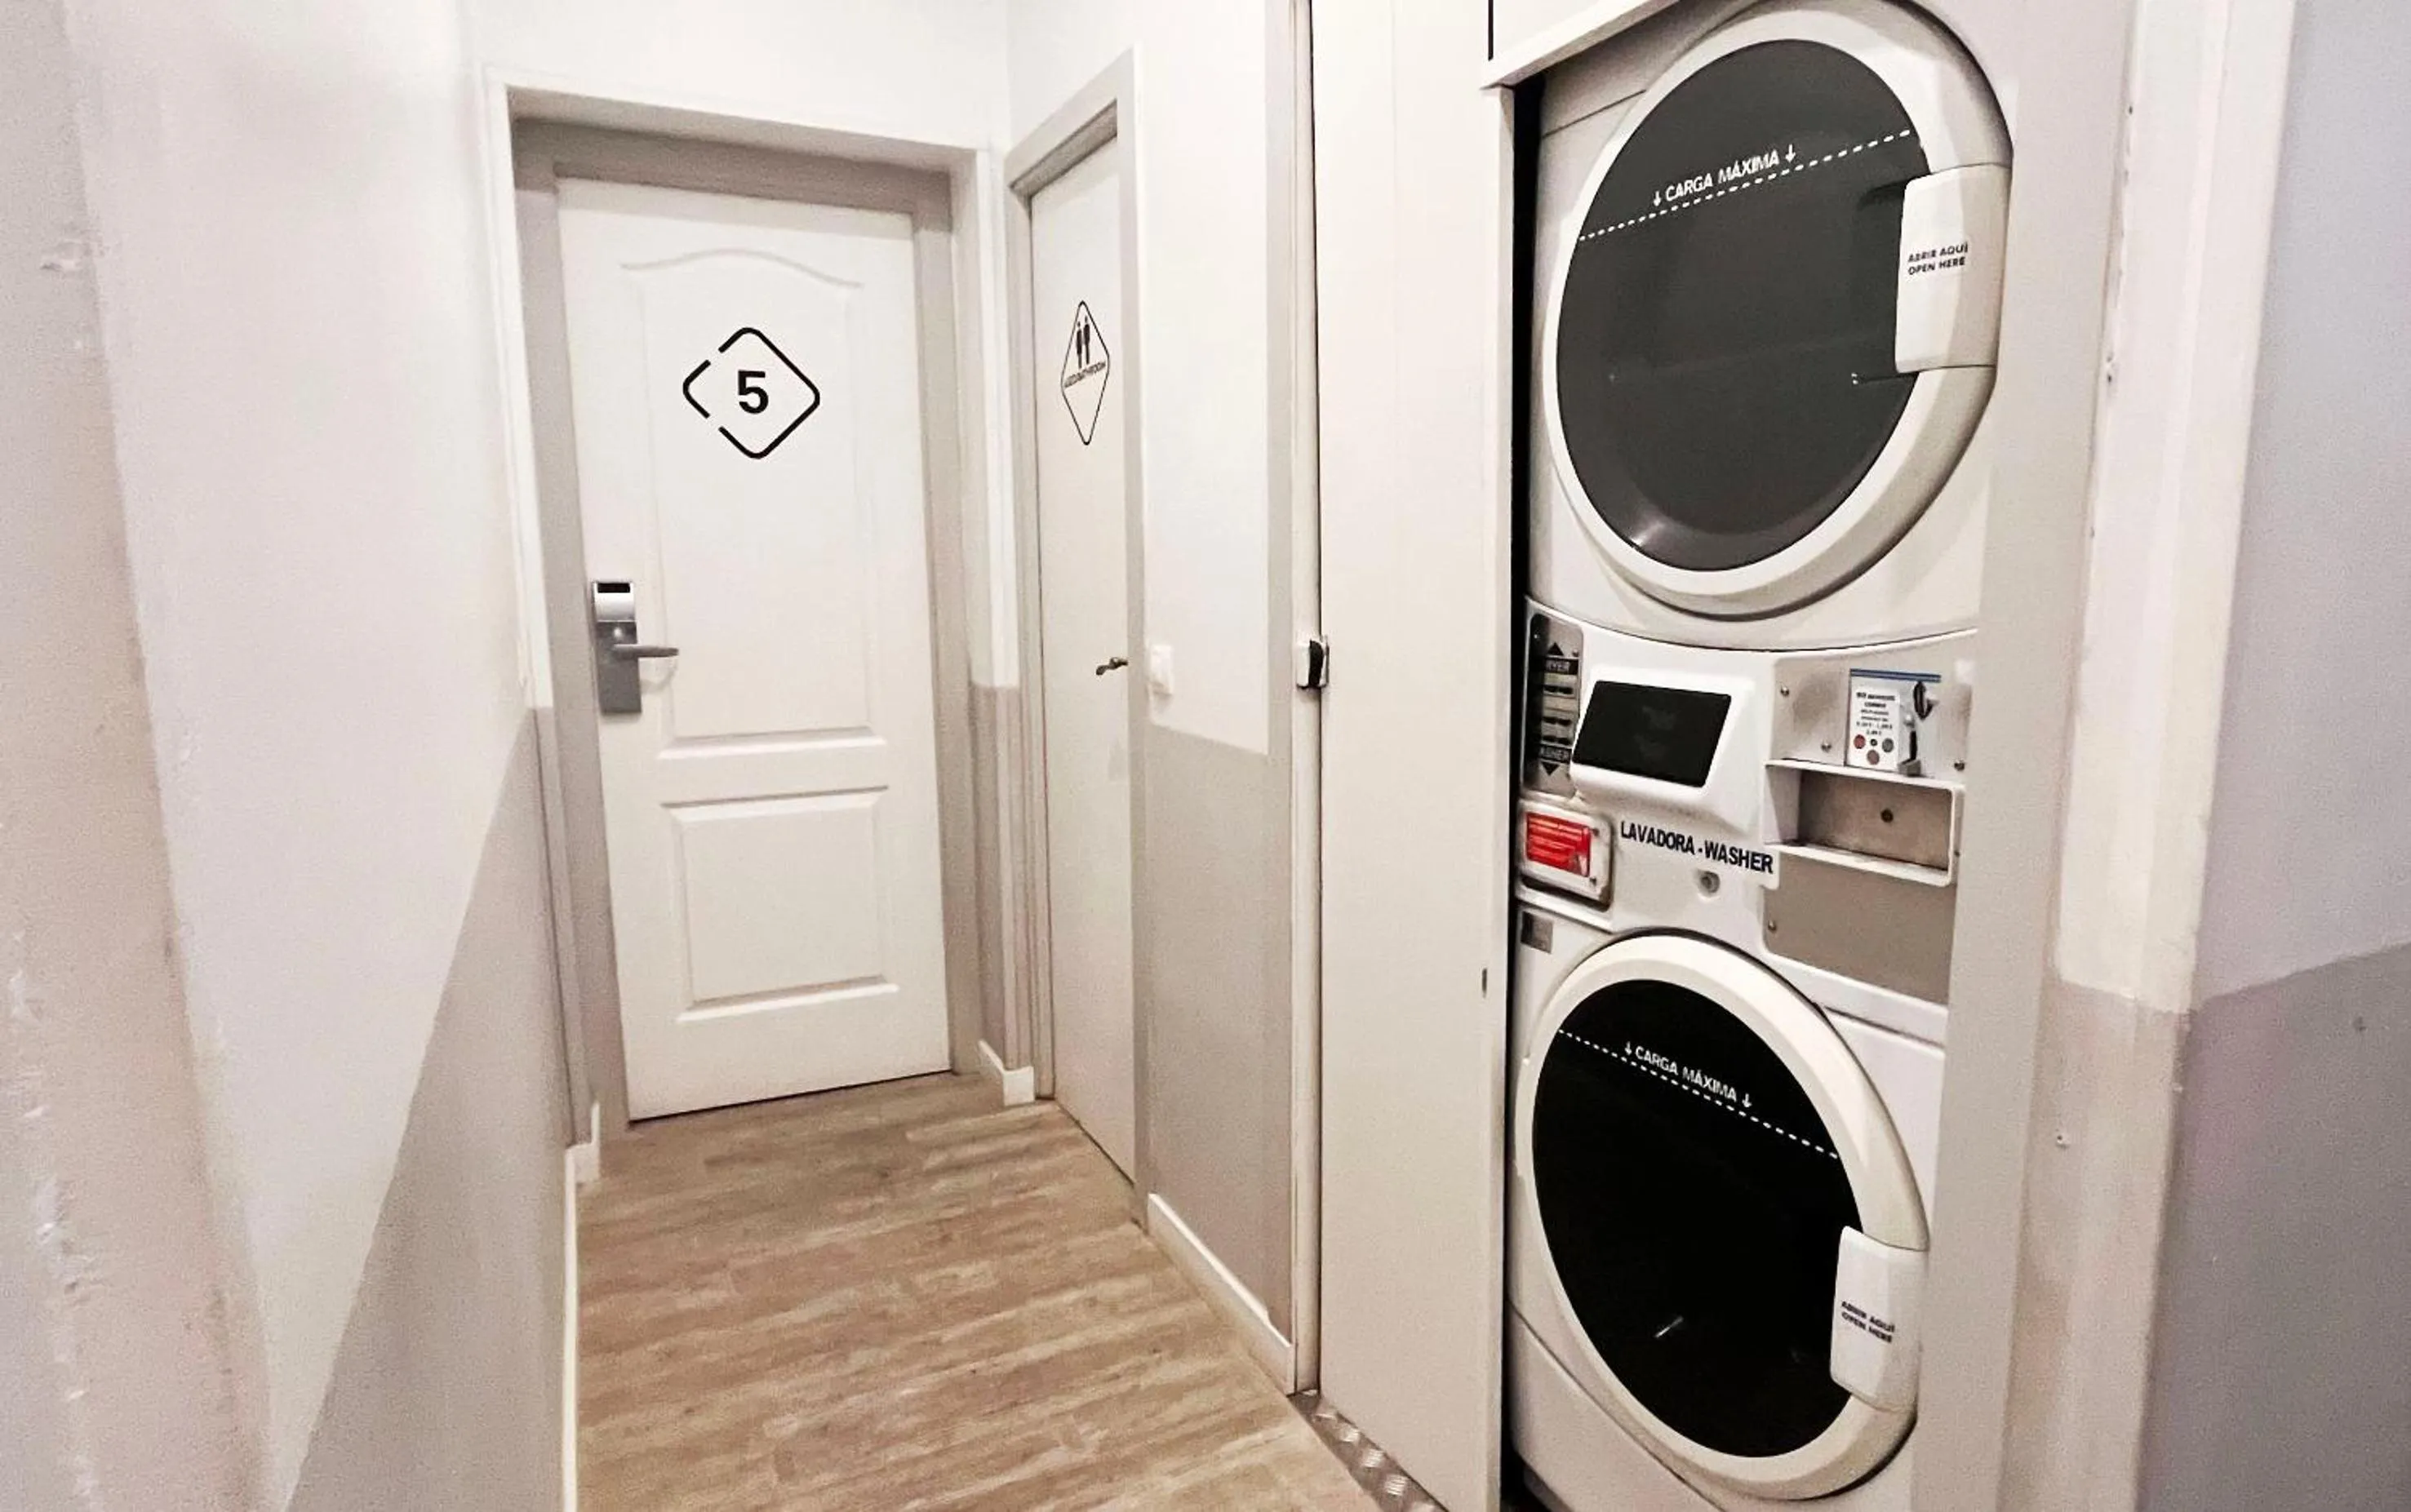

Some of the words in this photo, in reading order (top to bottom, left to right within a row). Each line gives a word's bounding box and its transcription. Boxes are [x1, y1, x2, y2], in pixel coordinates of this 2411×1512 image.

[1665, 172, 1713, 202] CARGA
[1718, 149, 1780, 184] MÁXIMA
[1907, 263, 1936, 275] OPEN
[1939, 256, 1965, 268] HERE
[738, 370, 769, 415] 5
[1621, 821, 1695, 855] LAVADORA
[1704, 840, 1774, 874] WASHER
[1635, 1045, 1679, 1075] CARGA
[1682, 1066, 1737, 1102] MÁXIMA
